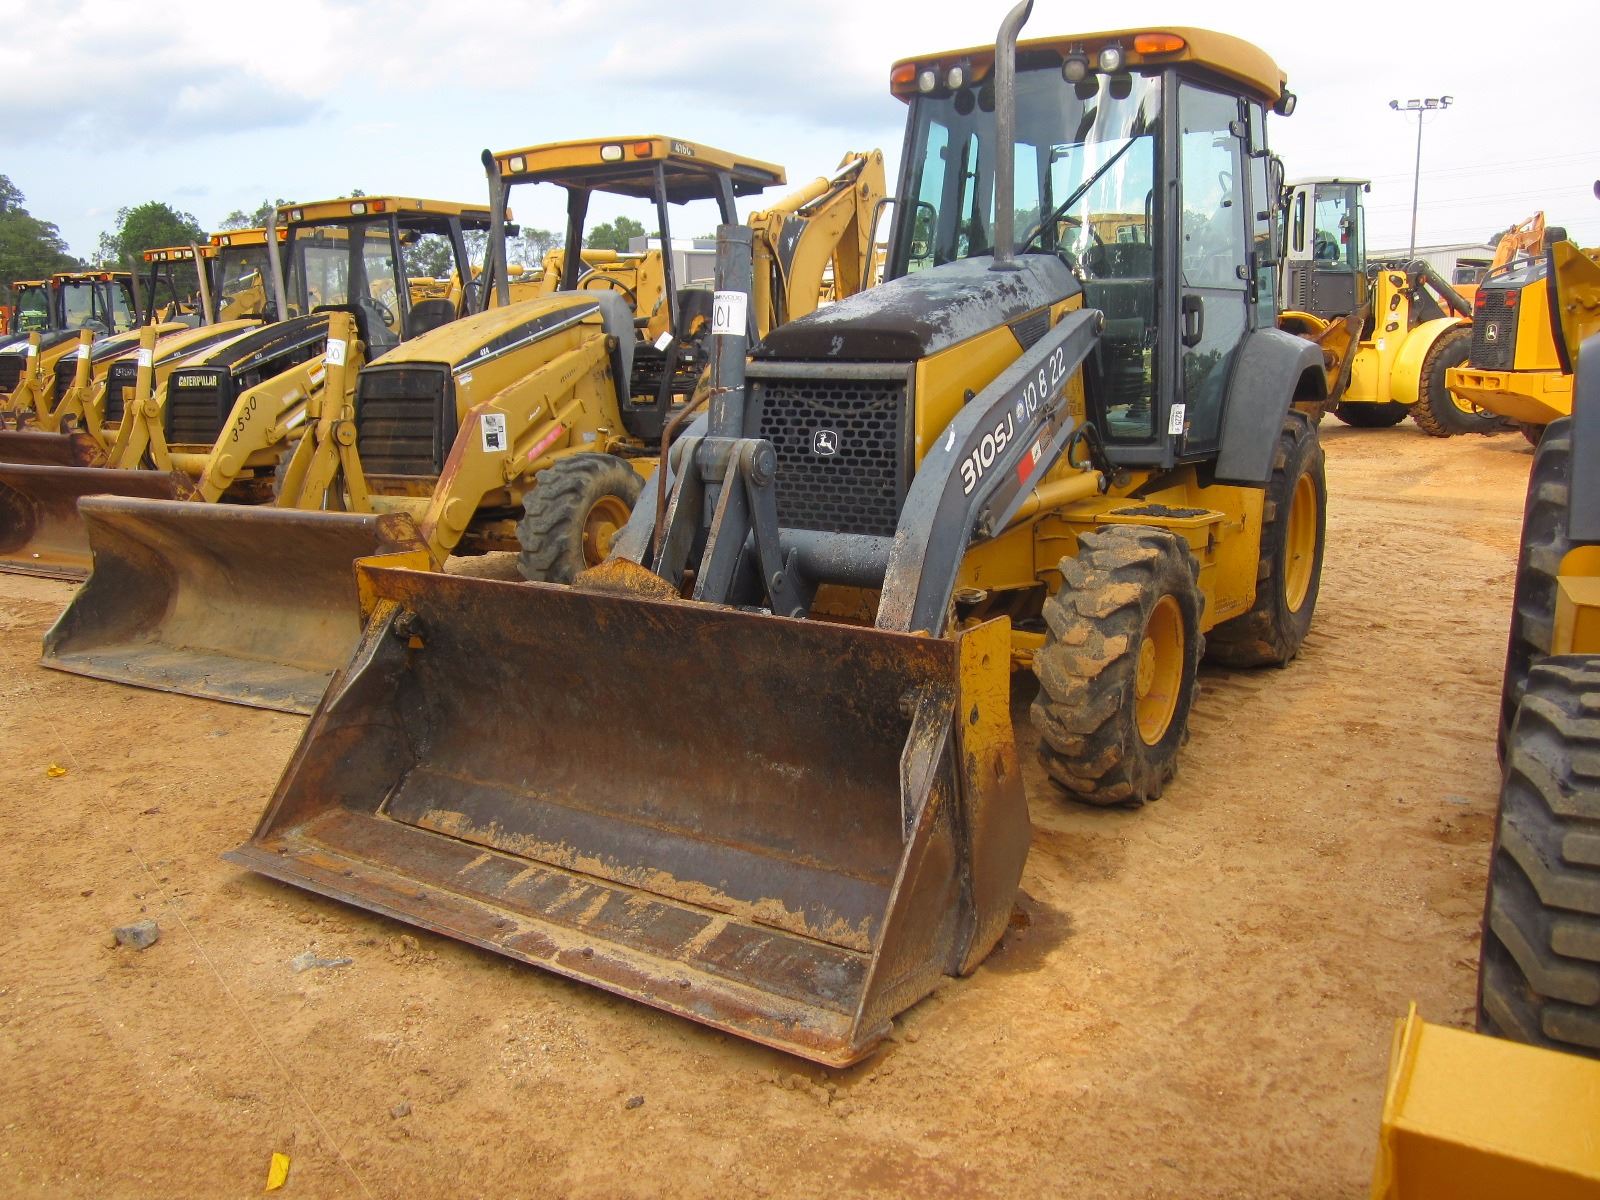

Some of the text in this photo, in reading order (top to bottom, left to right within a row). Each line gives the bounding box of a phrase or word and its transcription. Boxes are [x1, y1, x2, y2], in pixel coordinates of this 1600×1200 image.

[178, 375, 217, 387] CATERPILLAR
[232, 396, 256, 442] 3530
[960, 411, 1014, 495] 310SJ
